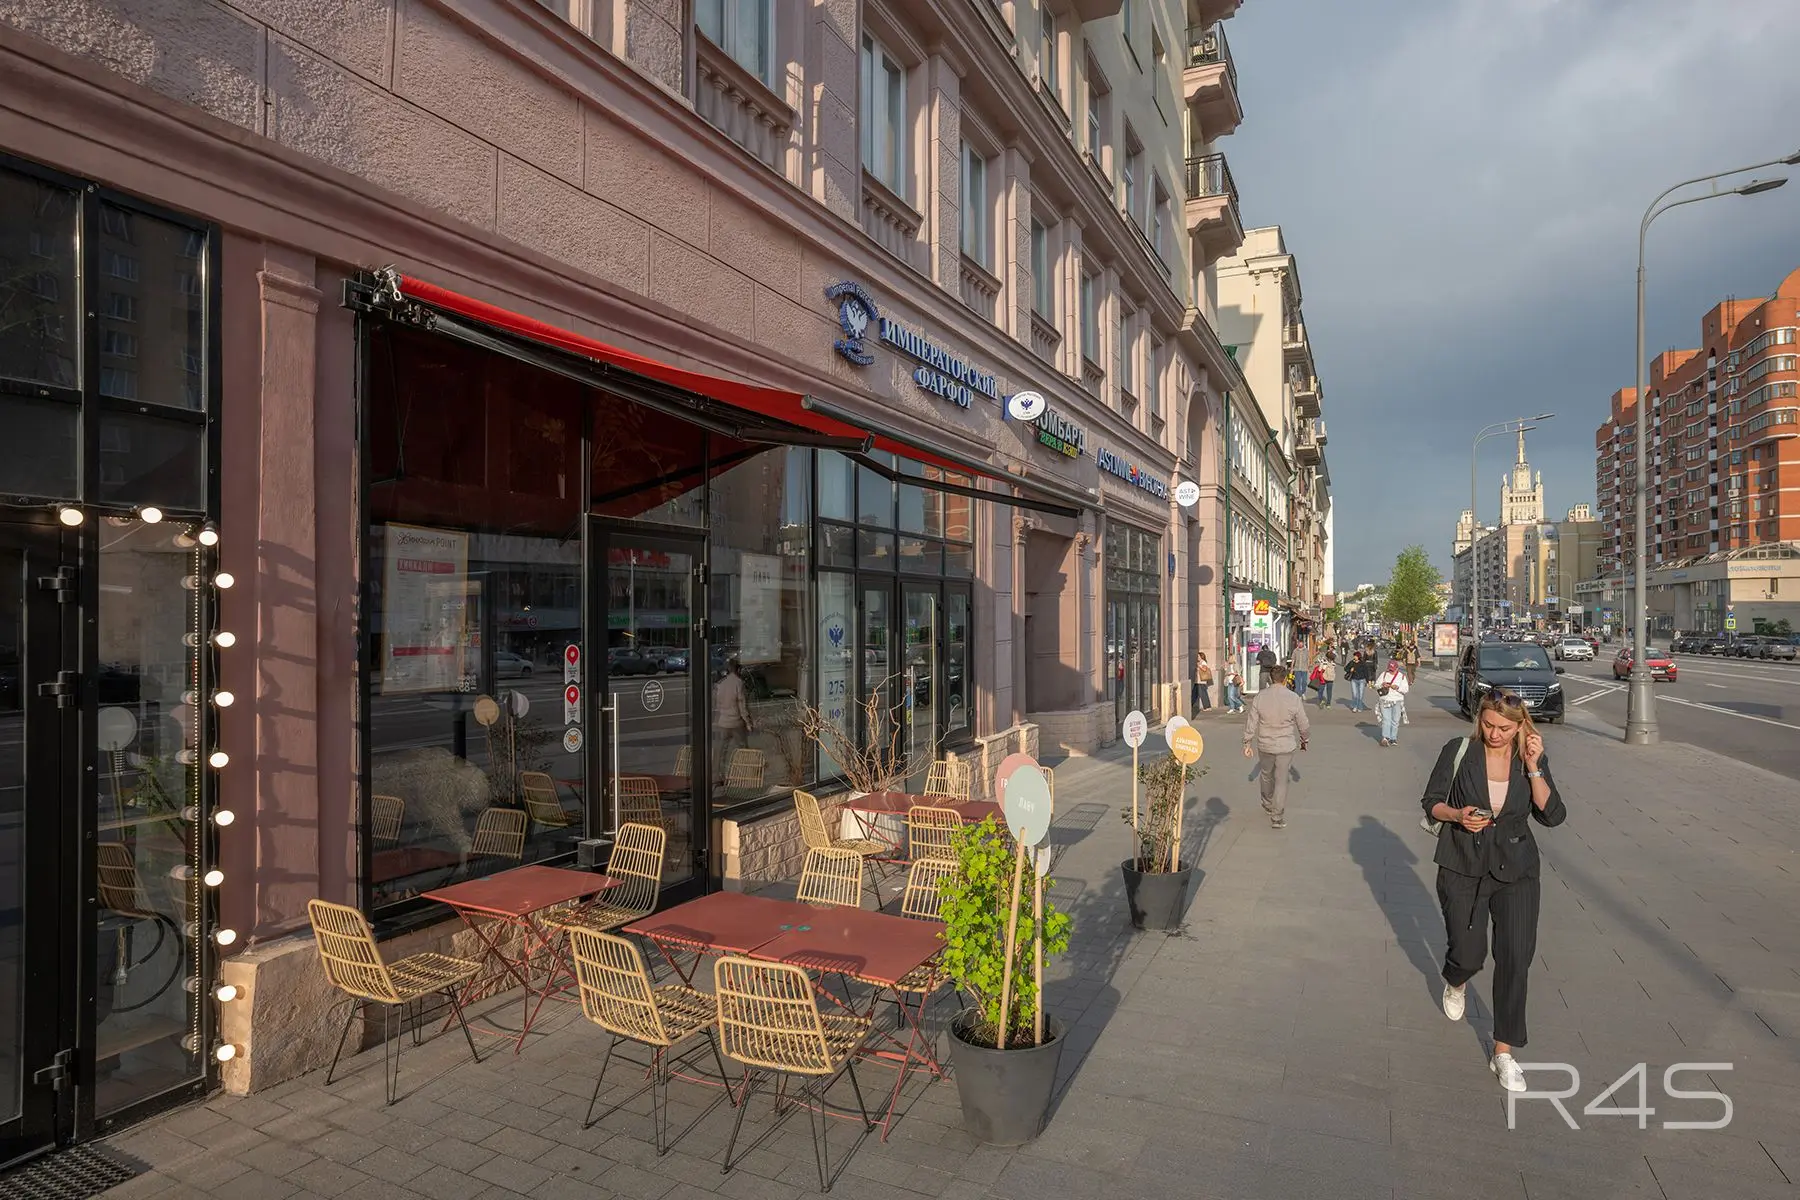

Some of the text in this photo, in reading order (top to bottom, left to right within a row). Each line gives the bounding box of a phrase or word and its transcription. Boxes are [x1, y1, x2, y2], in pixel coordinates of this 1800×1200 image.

[883, 318, 998, 400] ИМПЕРАТОРСКИЙ
[916, 366, 974, 410] ФАРФОР
[828, 679, 846, 695] 275
